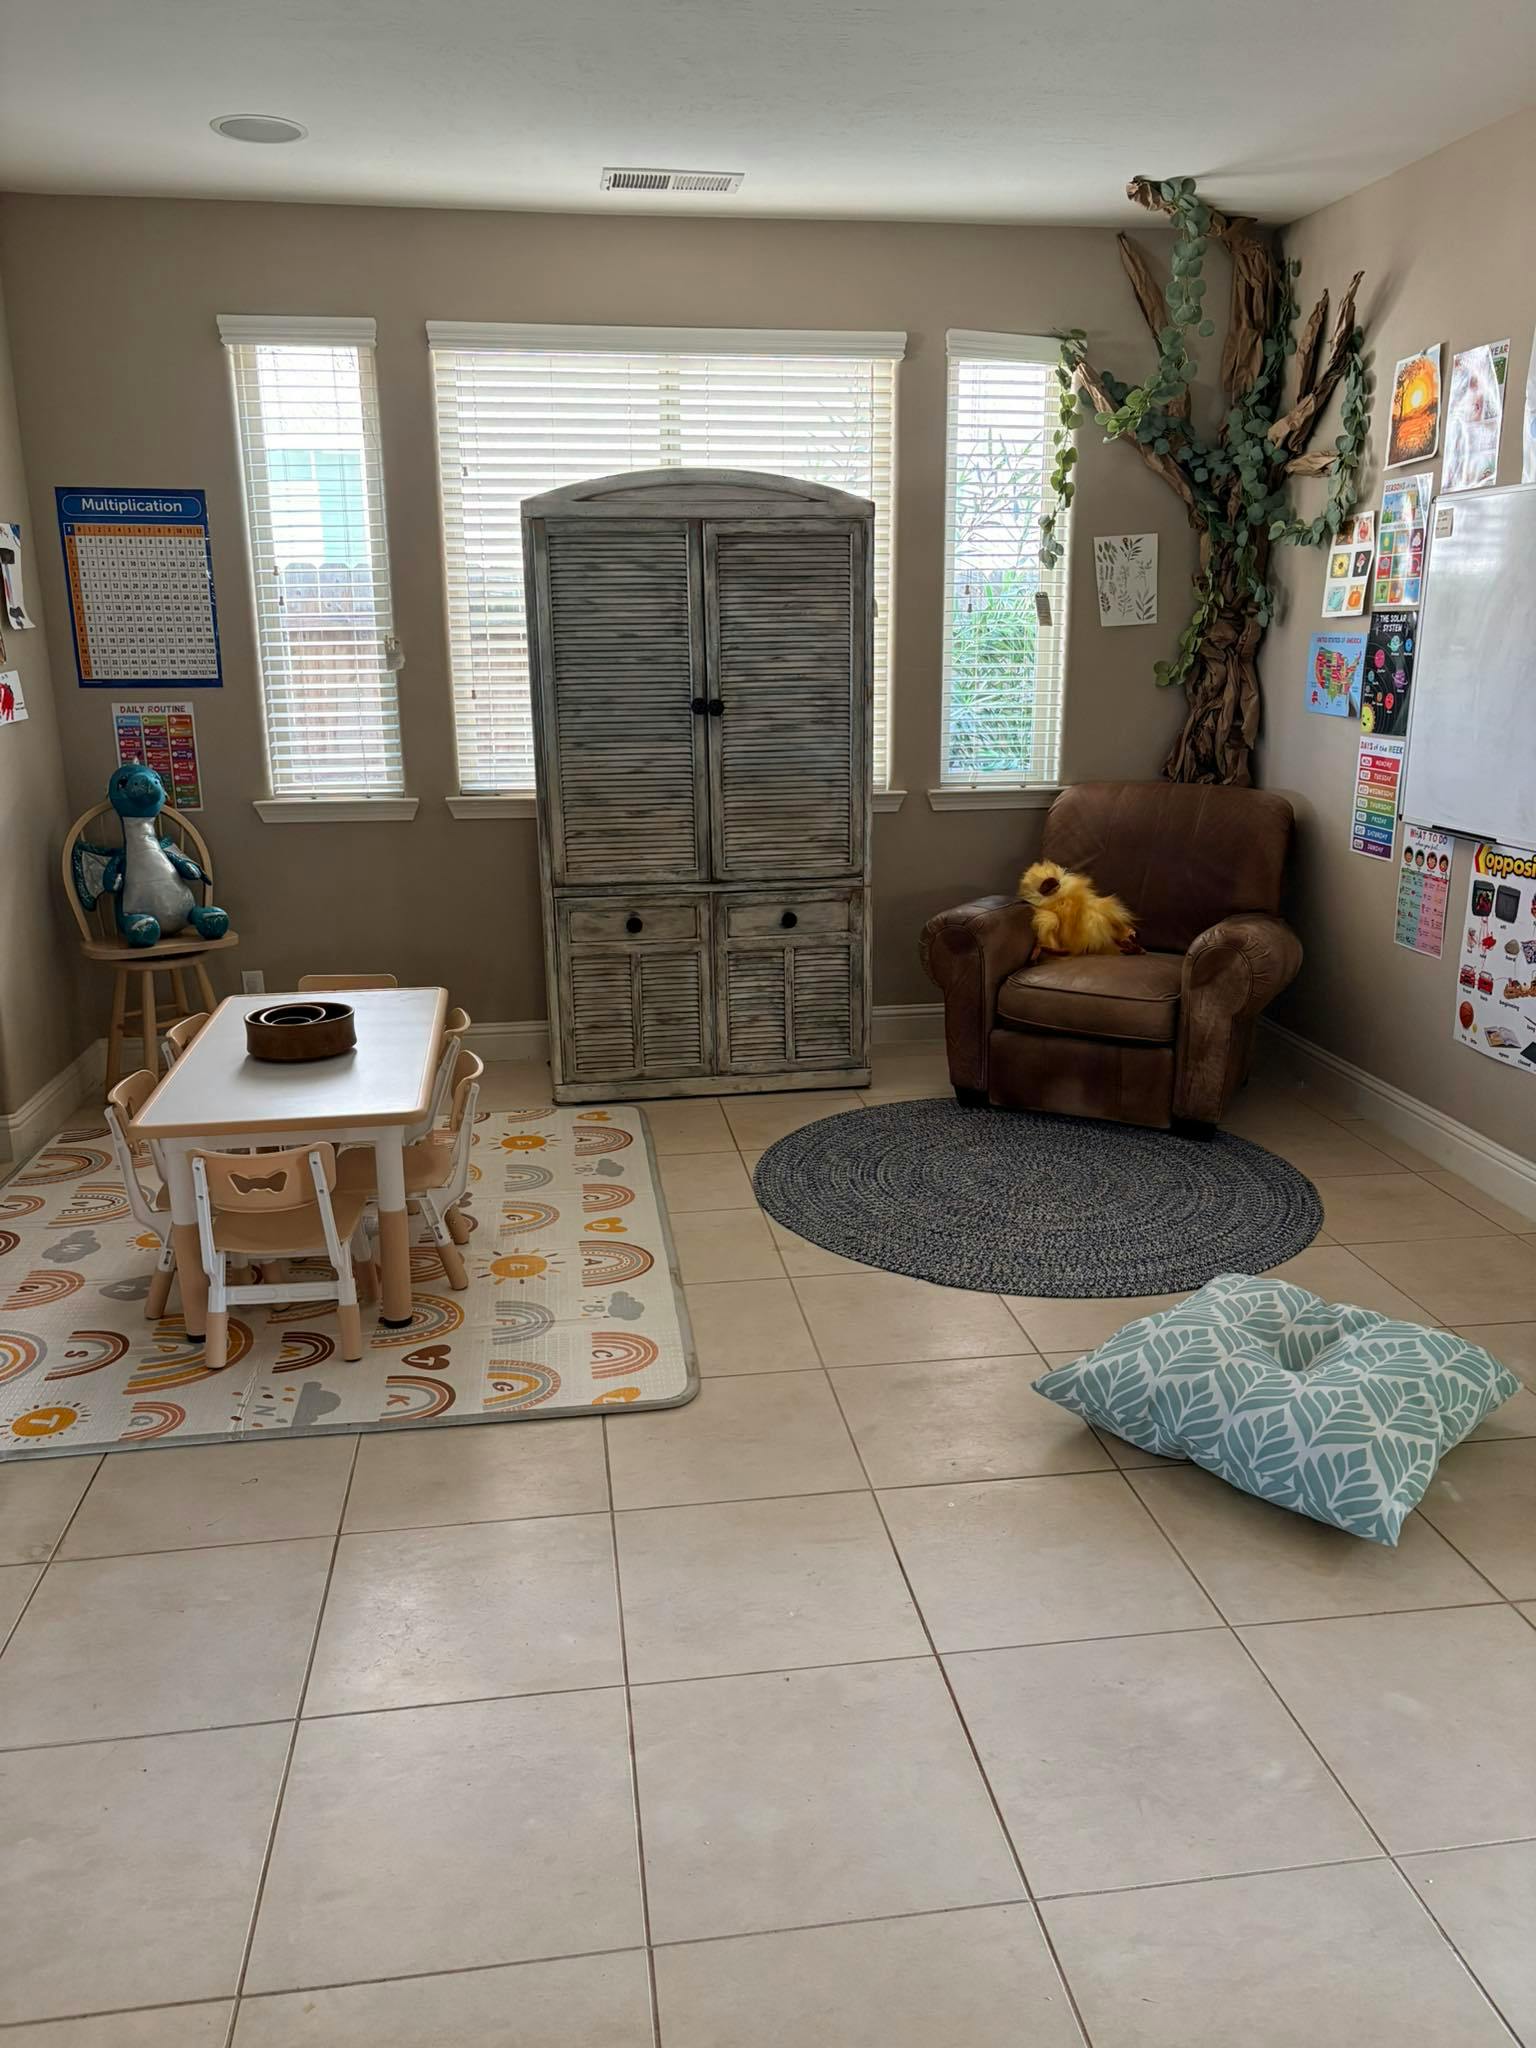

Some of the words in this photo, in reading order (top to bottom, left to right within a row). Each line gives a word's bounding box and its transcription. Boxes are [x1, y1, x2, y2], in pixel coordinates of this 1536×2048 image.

[81, 497, 182, 514] Multiplication
[1380, 614, 1390, 622] THE
[1390, 614, 1406, 622] SOLAR
[1382, 624, 1403, 632] SYSTEM
[120, 705, 144, 713] DAILY
[148, 704, 185, 713] ROUTINE
[1410, 828, 1426, 840] WHAT
[1429, 832, 1437, 842] TO
[1439, 834, 1448, 845] DO
[584, 1258, 602, 1267] A
[583, 1304, 606, 1313] B
[65, 1350, 88, 1358] S
[592, 1350, 613, 1360] C
[408, 1355, 435, 1366] J
[492, 1381, 514, 1392] G
[386, 1394, 410, 1406] K
[253, 1405, 277, 1416] N
